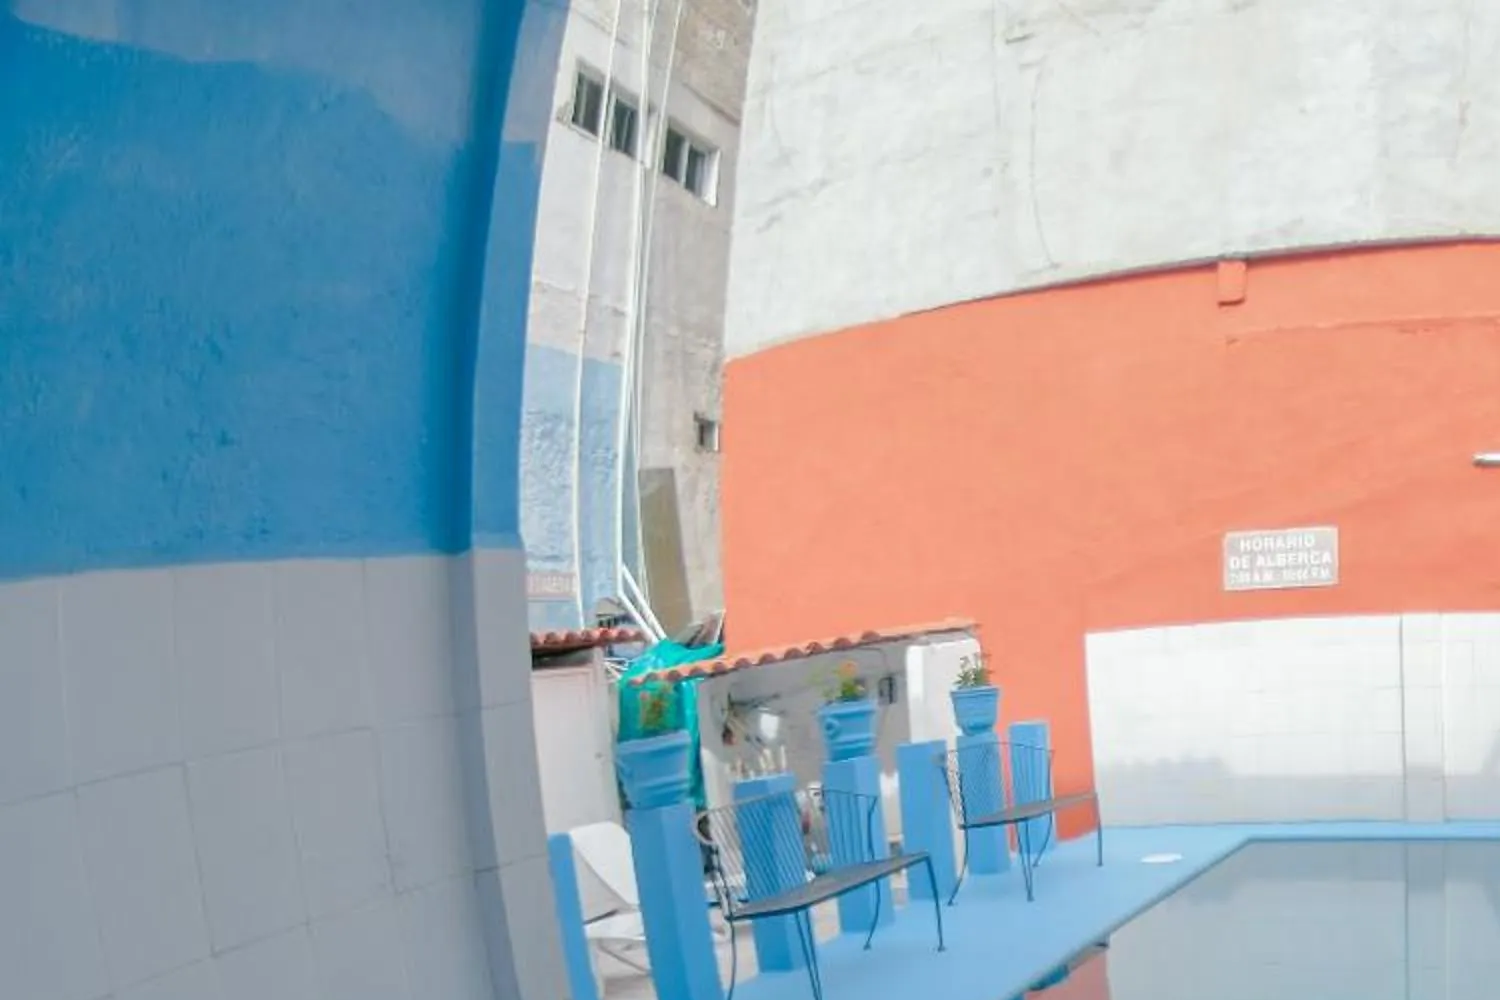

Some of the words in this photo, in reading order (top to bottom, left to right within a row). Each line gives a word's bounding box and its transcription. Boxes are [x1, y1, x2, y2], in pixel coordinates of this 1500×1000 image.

[1240, 534, 1315, 552] HORARIO
[1230, 556, 1250, 569] DE
[1256, 552, 1332, 567] ALBERCA
